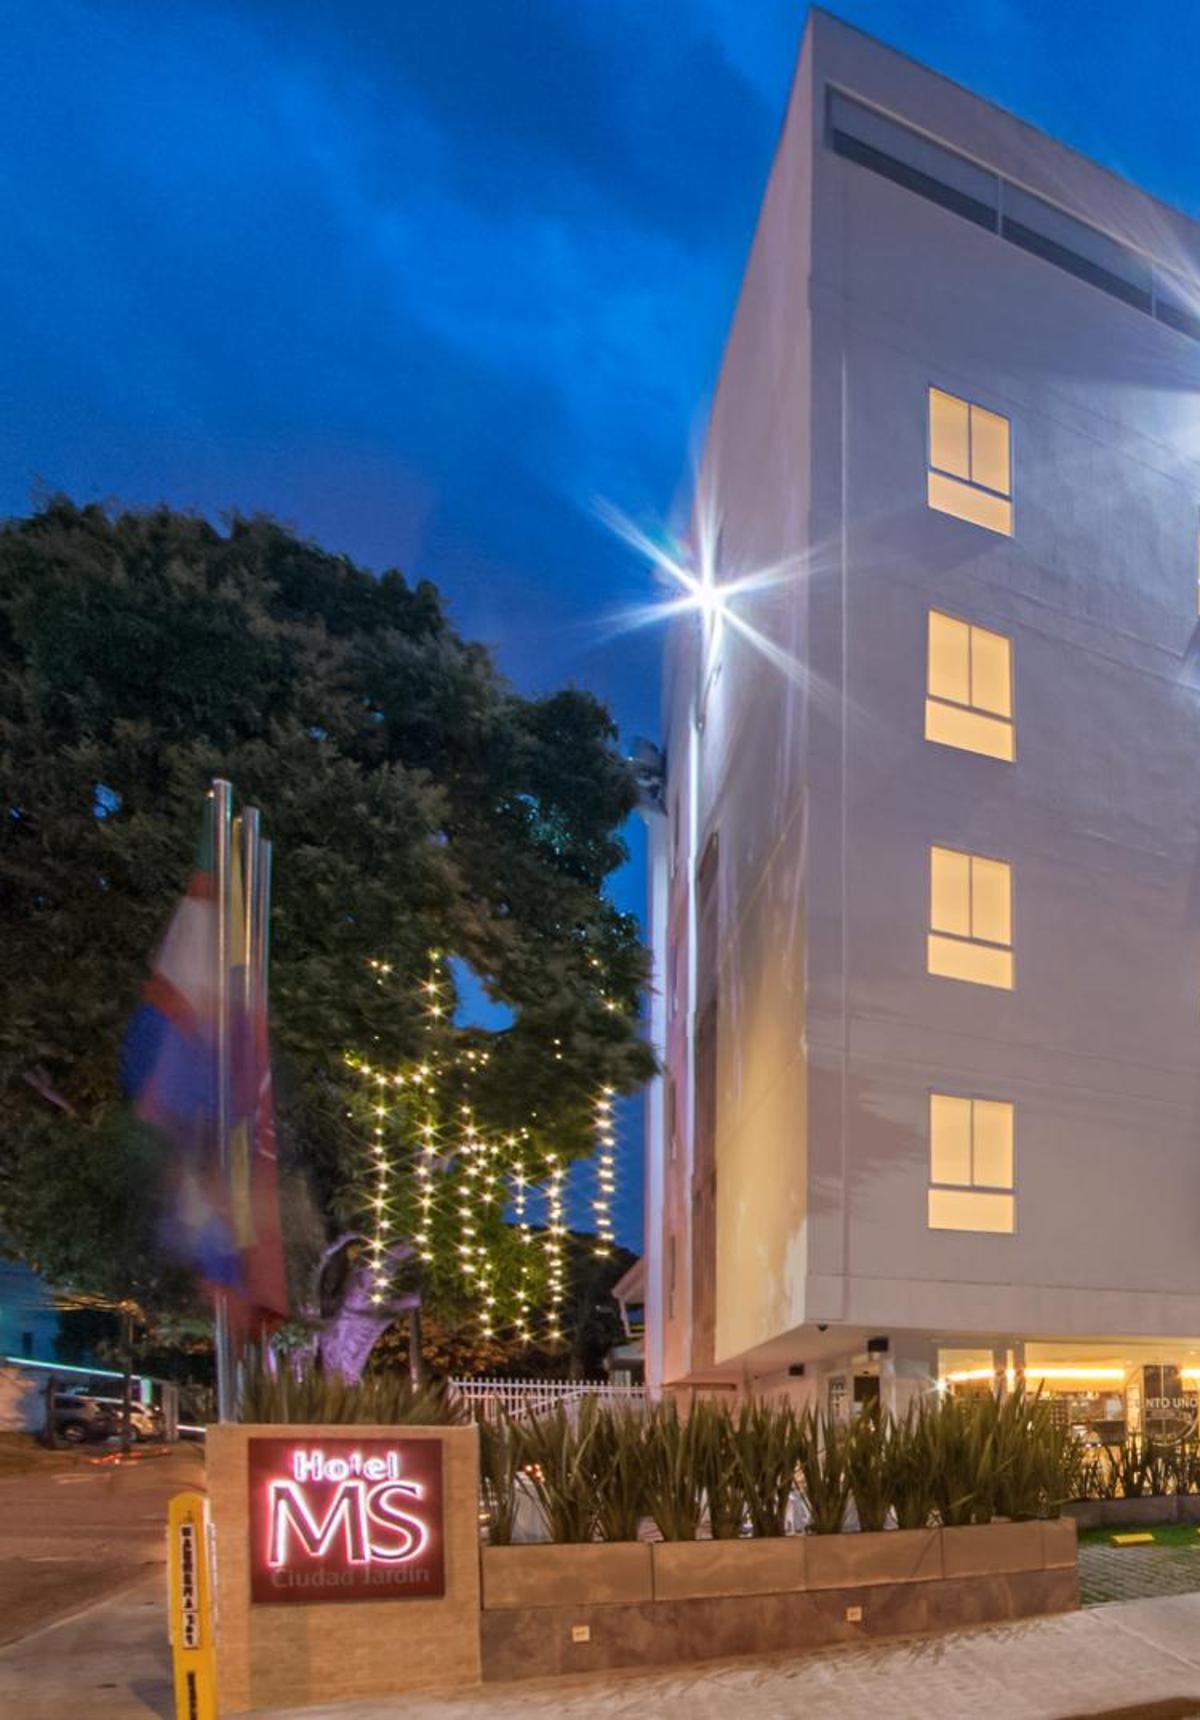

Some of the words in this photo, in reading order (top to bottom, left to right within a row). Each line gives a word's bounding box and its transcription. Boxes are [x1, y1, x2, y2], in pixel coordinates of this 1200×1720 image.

[1172, 1396, 1199, 1408] UNO
[294, 1450, 399, 1481] Hotel
[268, 1480, 428, 1567] MS
[271, 1567, 354, 1588] Ciudad
